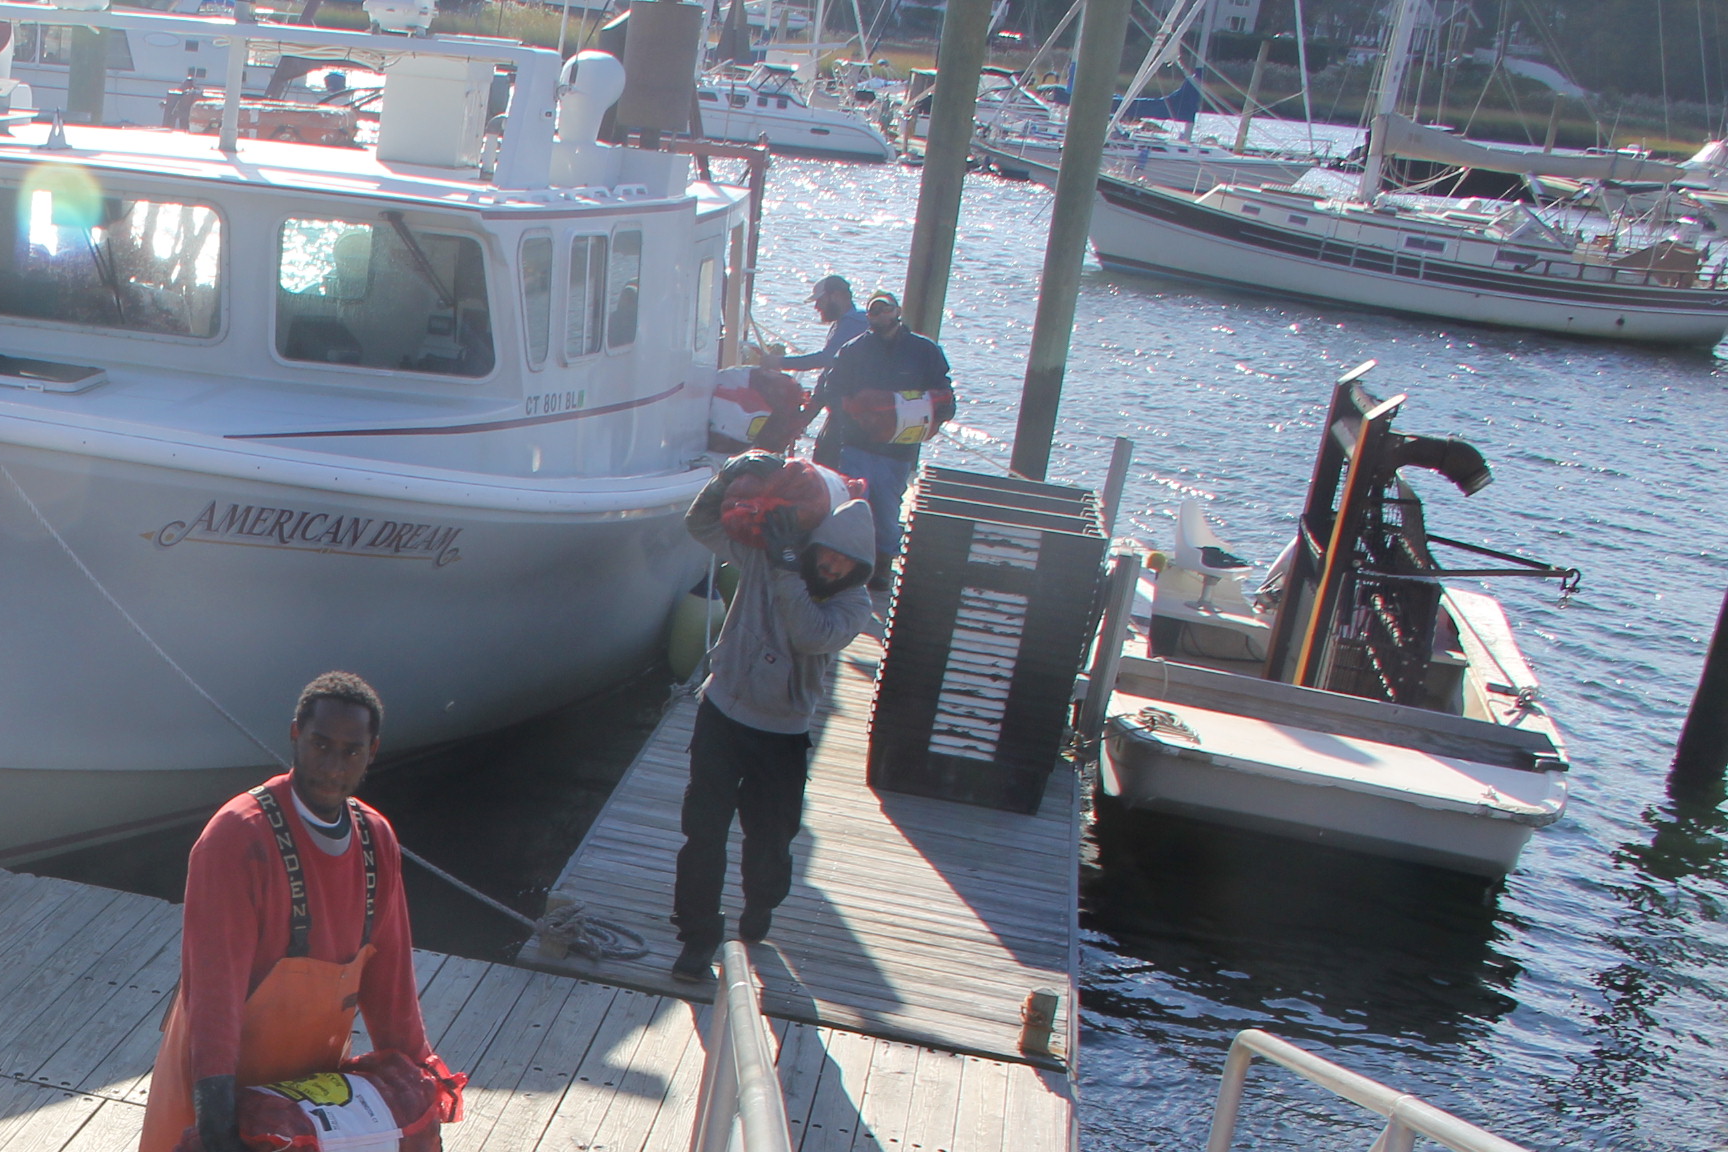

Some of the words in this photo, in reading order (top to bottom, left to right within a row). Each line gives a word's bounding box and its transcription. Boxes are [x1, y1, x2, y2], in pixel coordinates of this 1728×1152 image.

[525, 395, 540, 416] CT
[543, 392, 562, 414] 801
[158, 500, 374, 547] AMERICAN
[362, 519, 464, 567] DREAM
